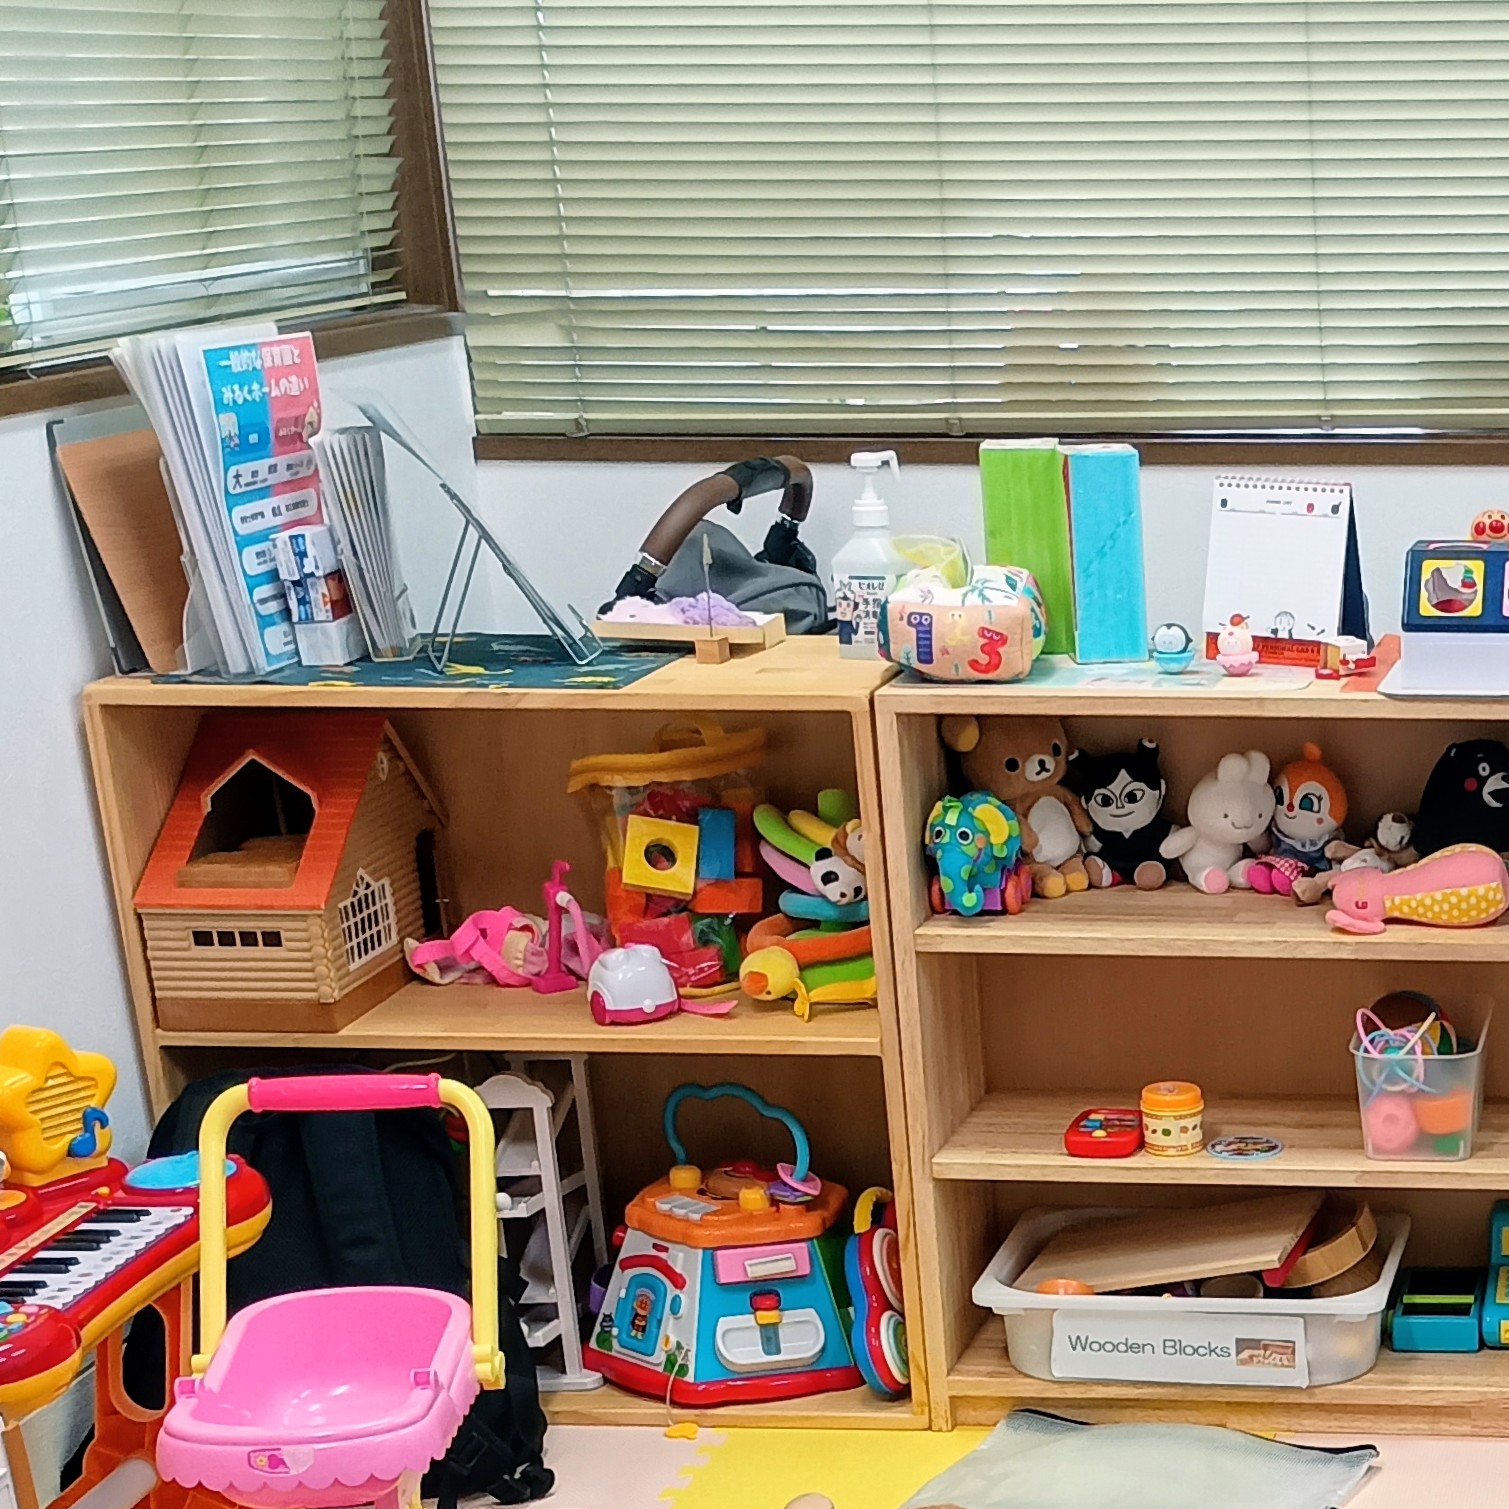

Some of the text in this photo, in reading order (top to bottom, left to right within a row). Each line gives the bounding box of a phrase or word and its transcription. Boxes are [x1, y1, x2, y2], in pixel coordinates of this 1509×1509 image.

[907, 612, 934, 665] 1
[967, 626, 1009, 674] 3
[1067, 1334, 1232, 1358] Wooden Blocks
